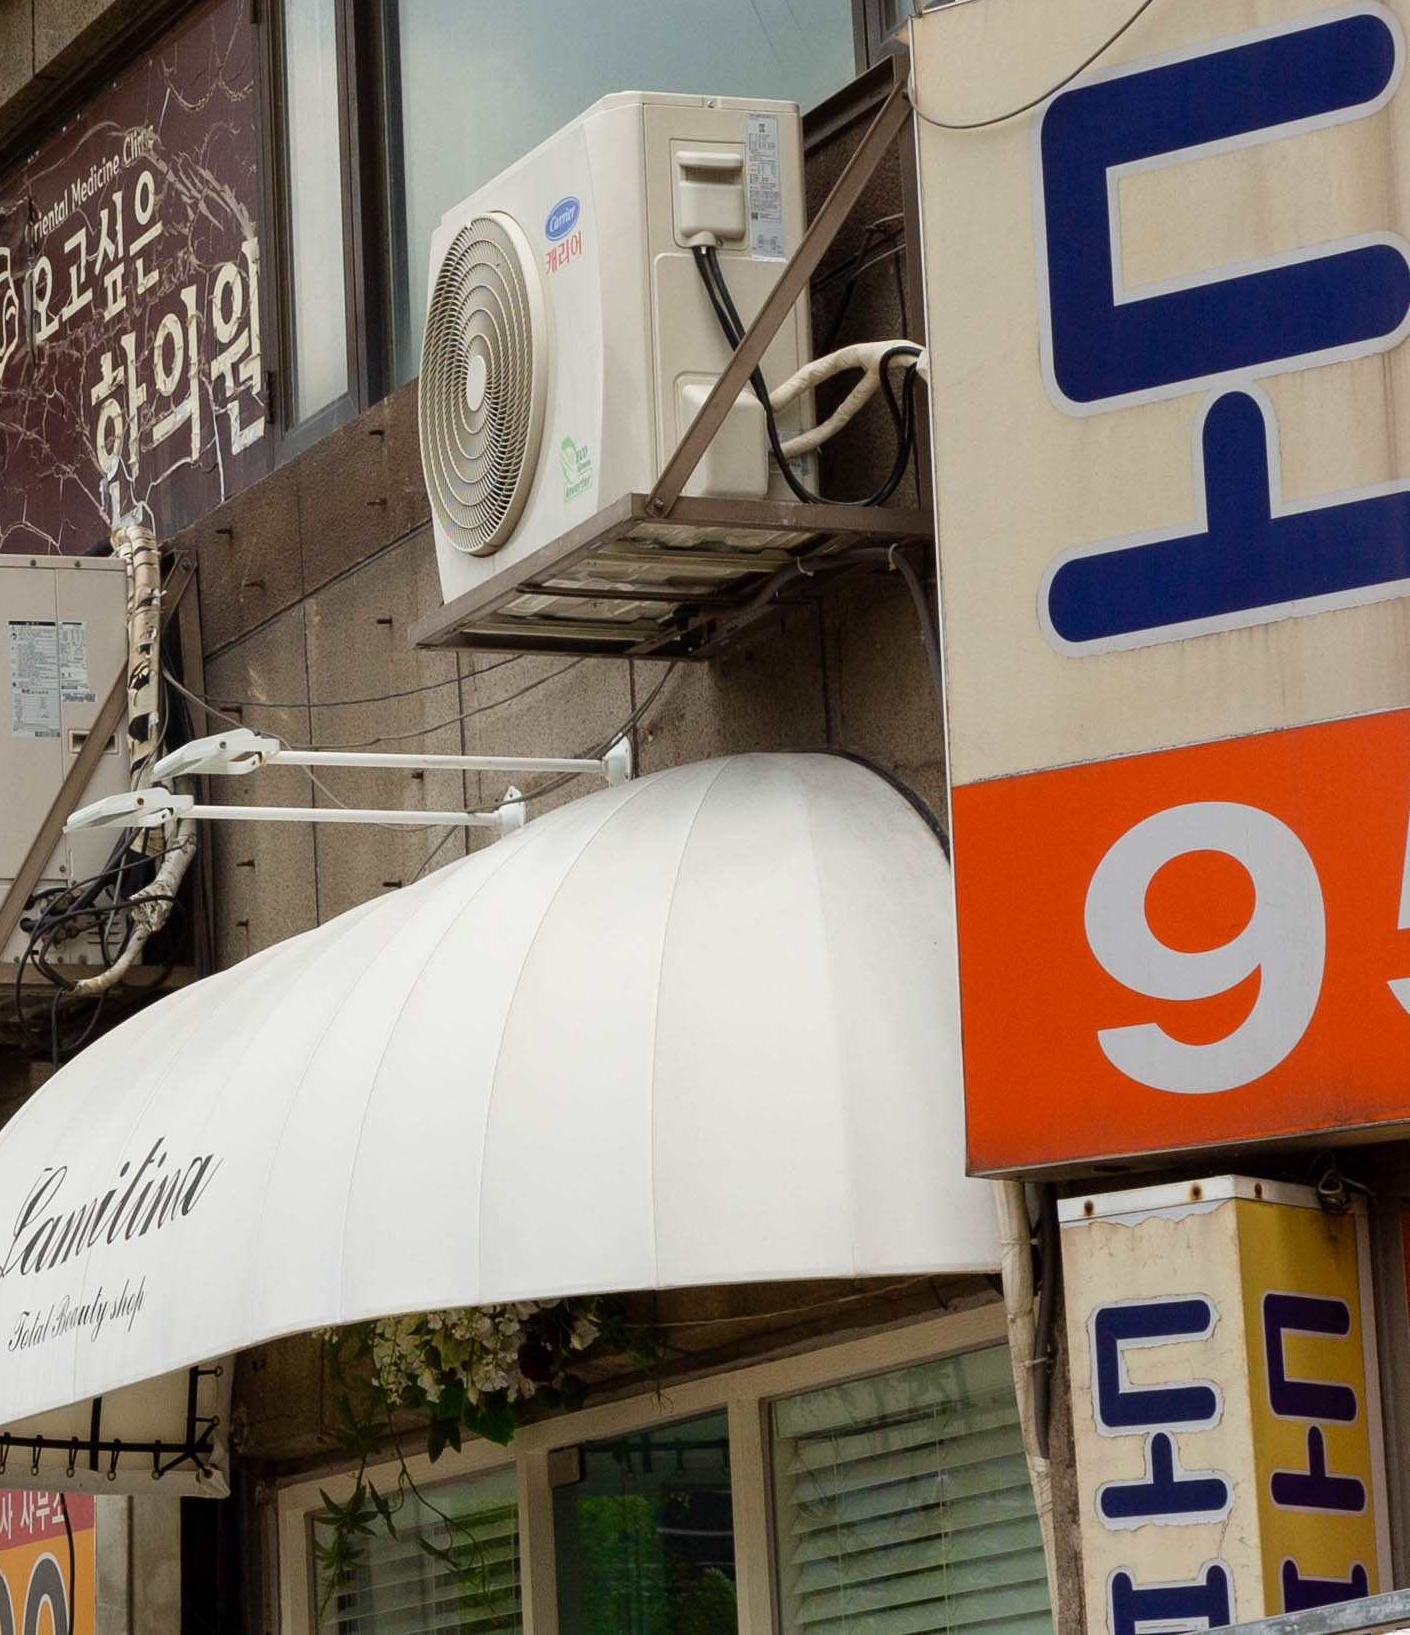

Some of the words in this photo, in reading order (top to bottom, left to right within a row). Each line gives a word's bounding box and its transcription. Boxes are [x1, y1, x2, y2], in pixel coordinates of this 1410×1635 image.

[71, 155, 119, 210] Medicine
[32, 169, 163, 345] 오고싶은
[545, 229, 583, 276] 캐리어
[90, 235, 266, 530] 한의원
[7, 1308, 54, 1352] Total
